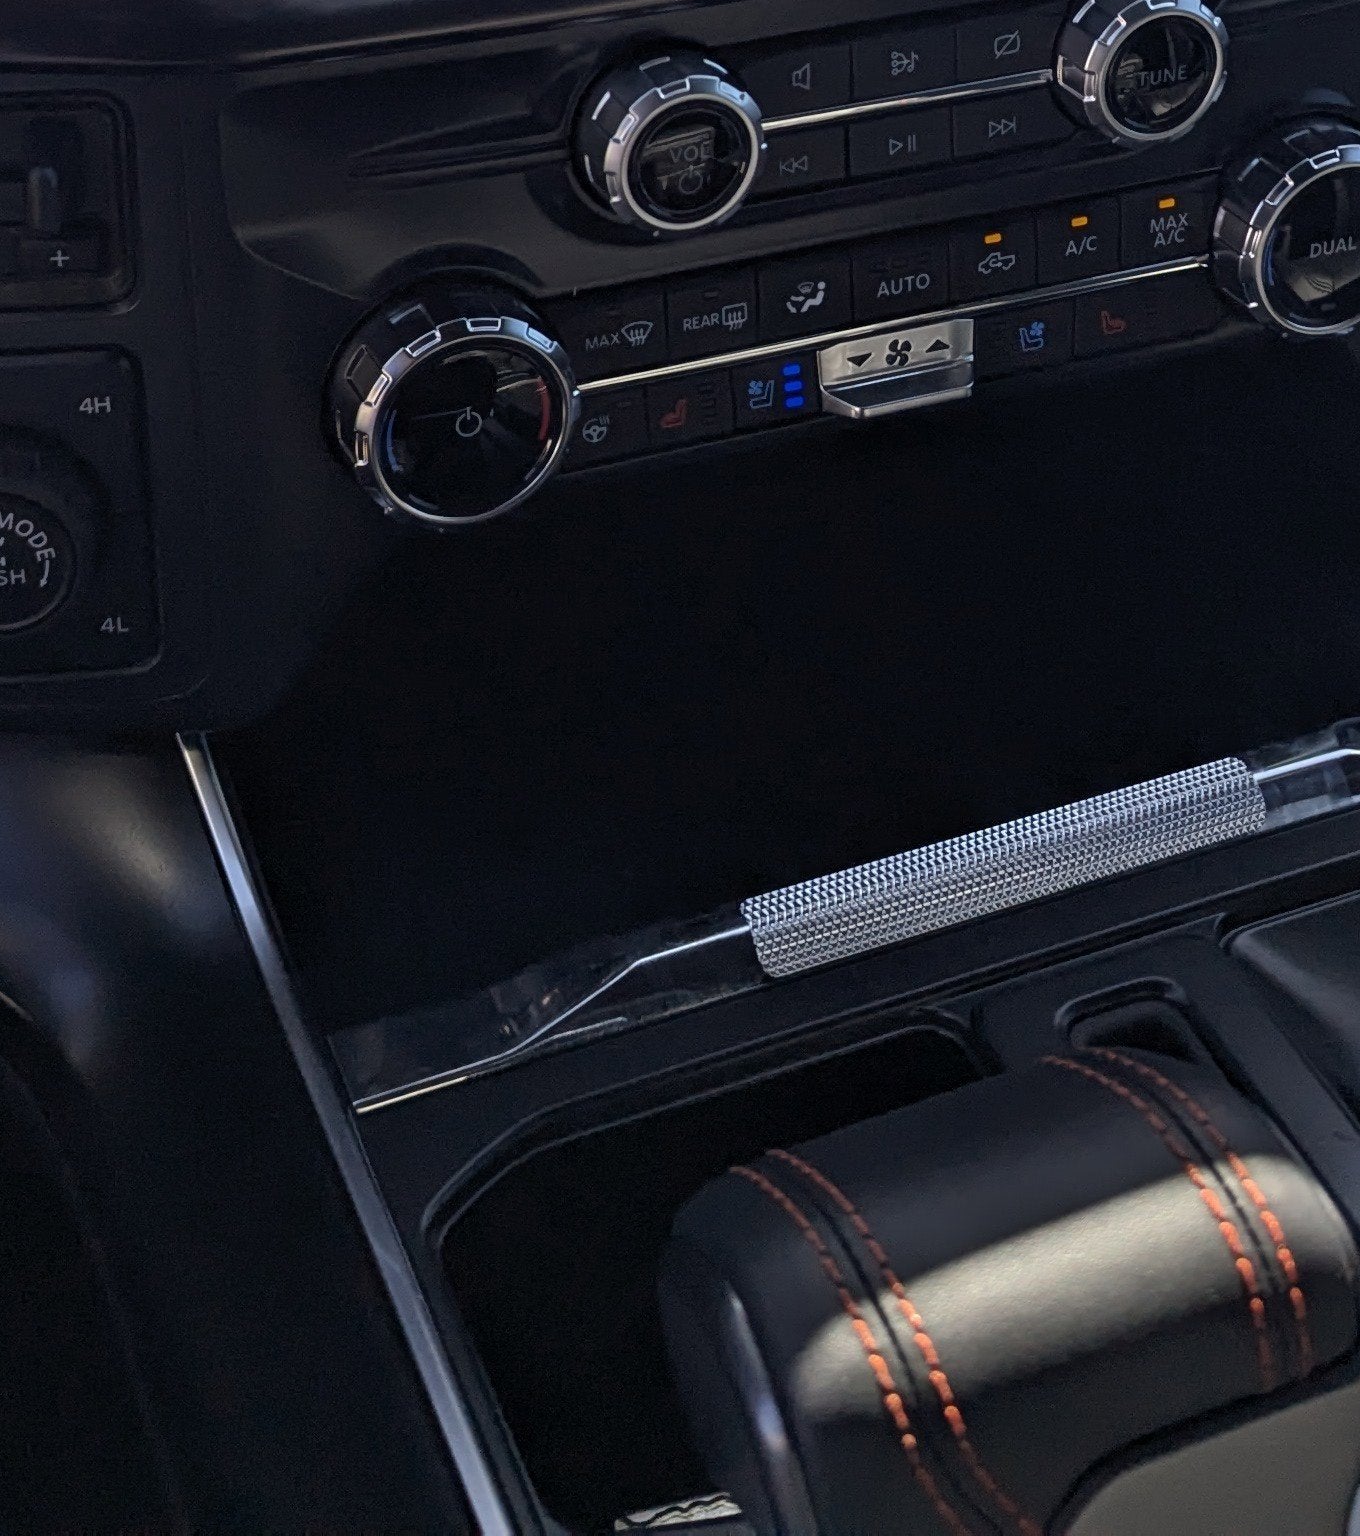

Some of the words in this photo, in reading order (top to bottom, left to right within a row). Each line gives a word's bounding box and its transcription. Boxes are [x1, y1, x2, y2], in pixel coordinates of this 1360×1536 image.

[1139, 64, 1189, 87] TUNE
[669, 142, 711, 163] VOL
[1149, 213, 1189, 234] MAX
[1065, 235, 1098, 256] A/C
[1153, 227, 1186, 248] A/C
[1309, 236, 1358, 259] DUAL
[876, 273, 931, 298] AUTO
[682, 313, 720, 332] REAR
[585, 332, 621, 352] MAX
[78, 396, 112, 415] 4H
[100, 616, 129, 634] 4L
